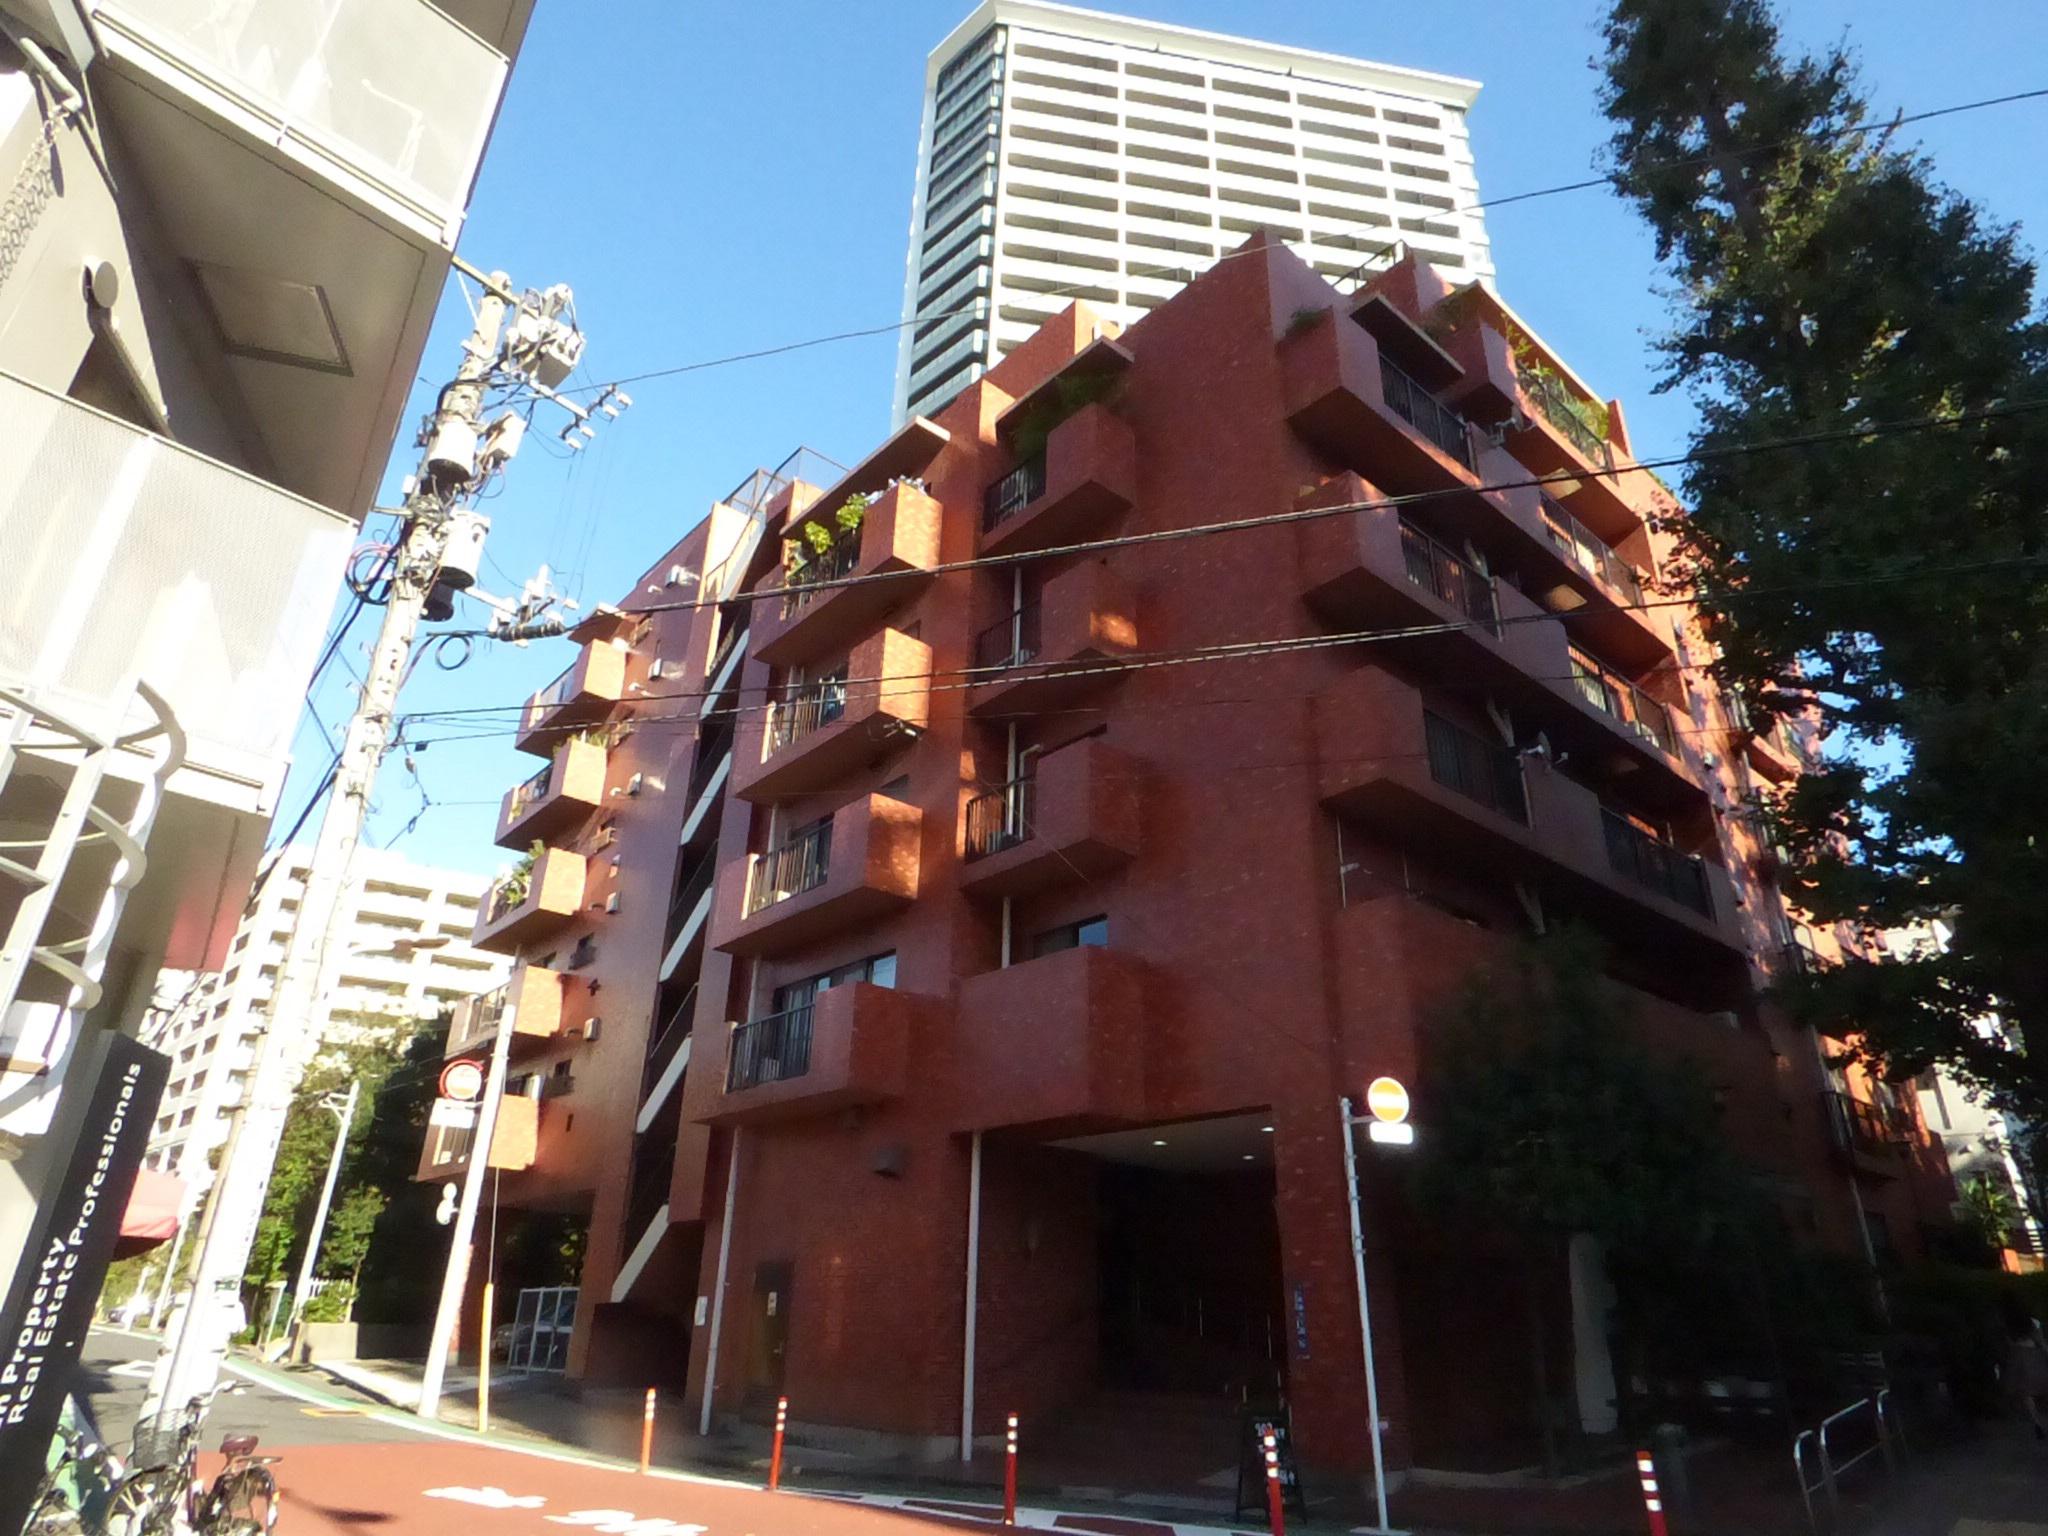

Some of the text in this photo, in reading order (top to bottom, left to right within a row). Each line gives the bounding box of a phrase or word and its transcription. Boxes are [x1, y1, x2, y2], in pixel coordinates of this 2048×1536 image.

[0, 1237, 66, 1384] Property
[7, 1063, 141, 1424] Real Estate Professionals
